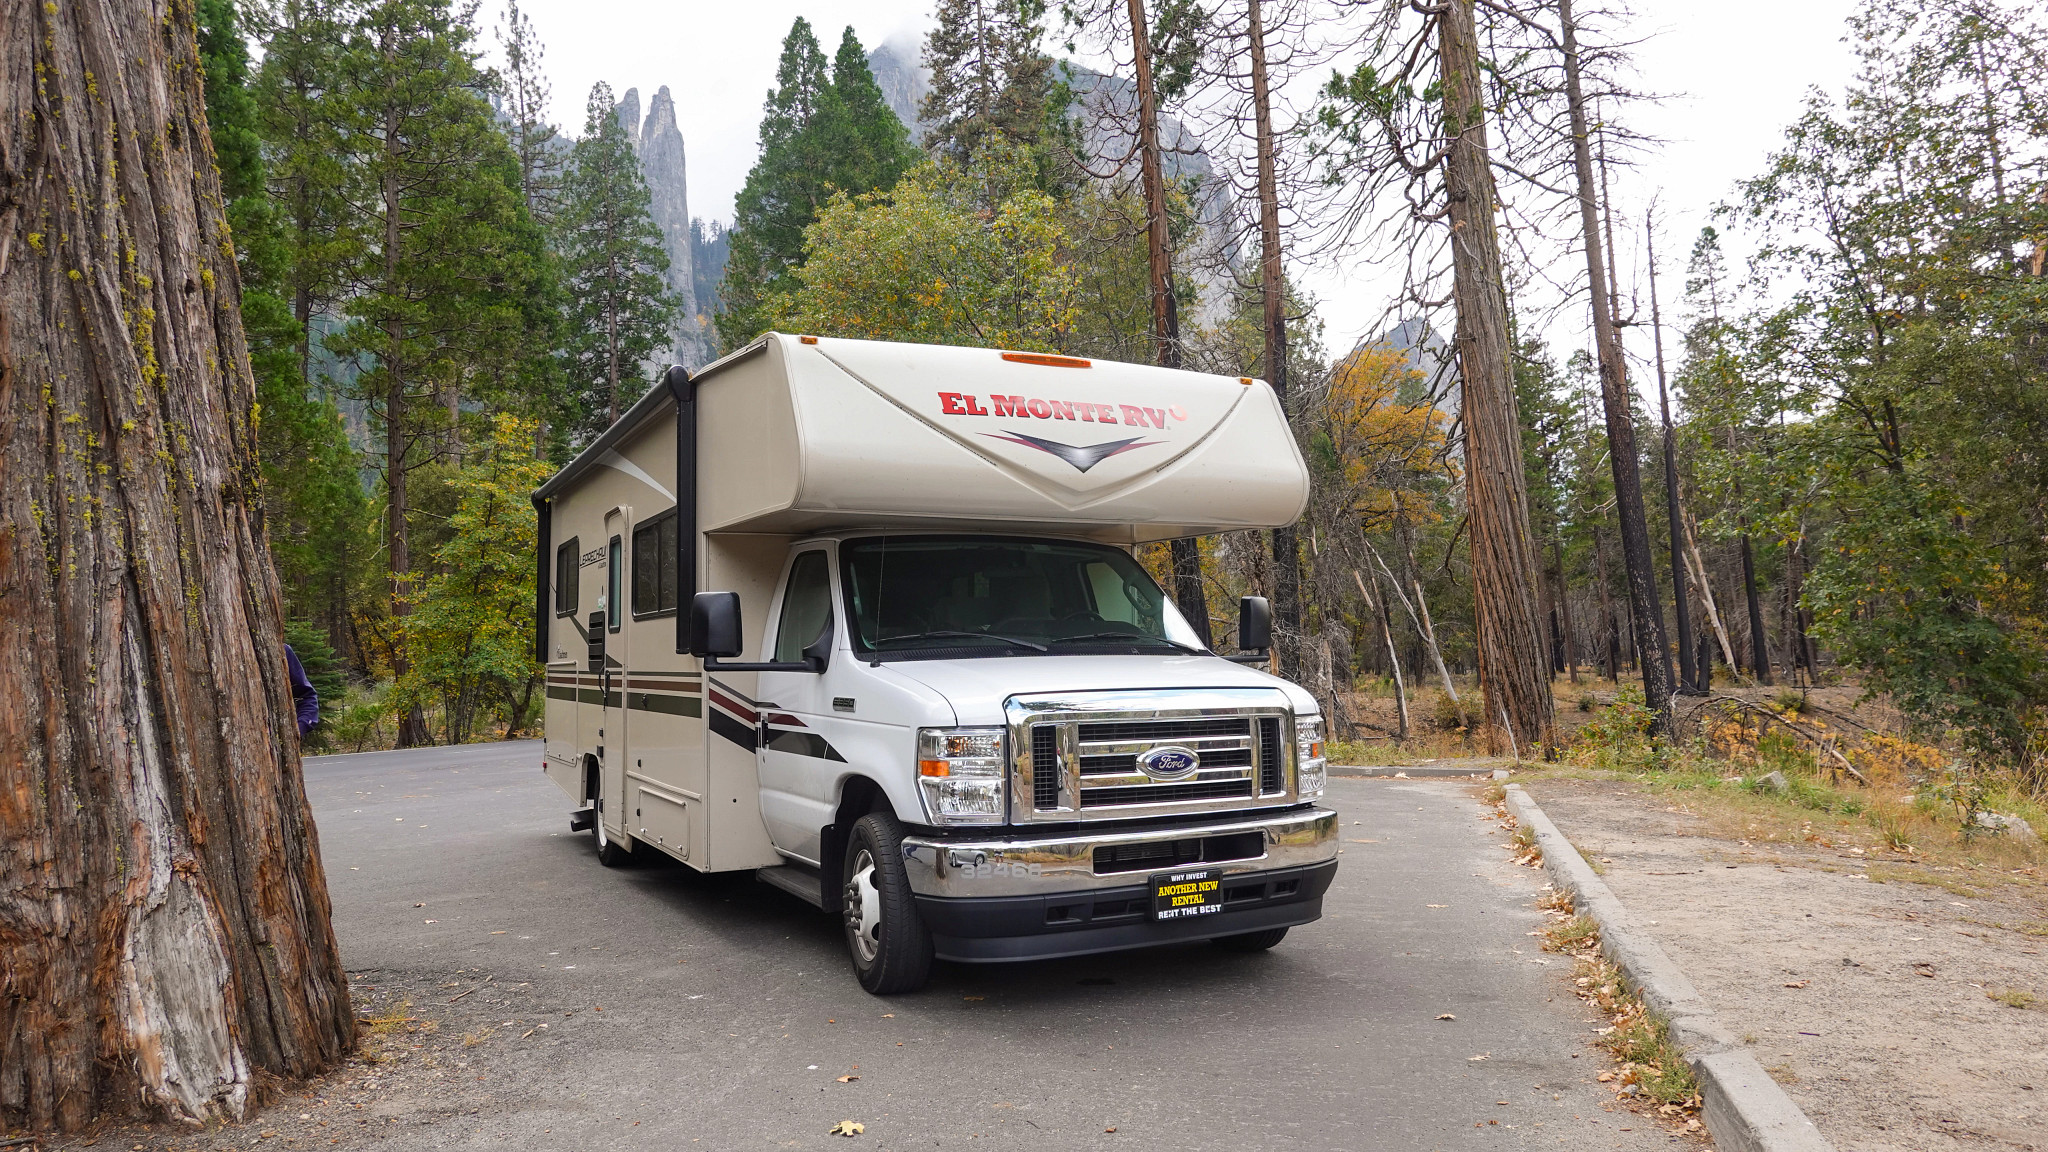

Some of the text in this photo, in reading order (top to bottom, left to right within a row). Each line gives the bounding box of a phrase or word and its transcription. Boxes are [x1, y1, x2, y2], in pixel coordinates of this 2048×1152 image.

[938, 391, 1165, 429] EL MONTE RV
[1158, 755, 1186, 769] Ford
[1170, 872, 1208, 882] WHY INVEST
[1158, 881, 1219, 896] ANOTHER NEW
[1172, 894, 1204, 906] RENTAL
[1158, 904, 1221, 919] RENT THE BEST
